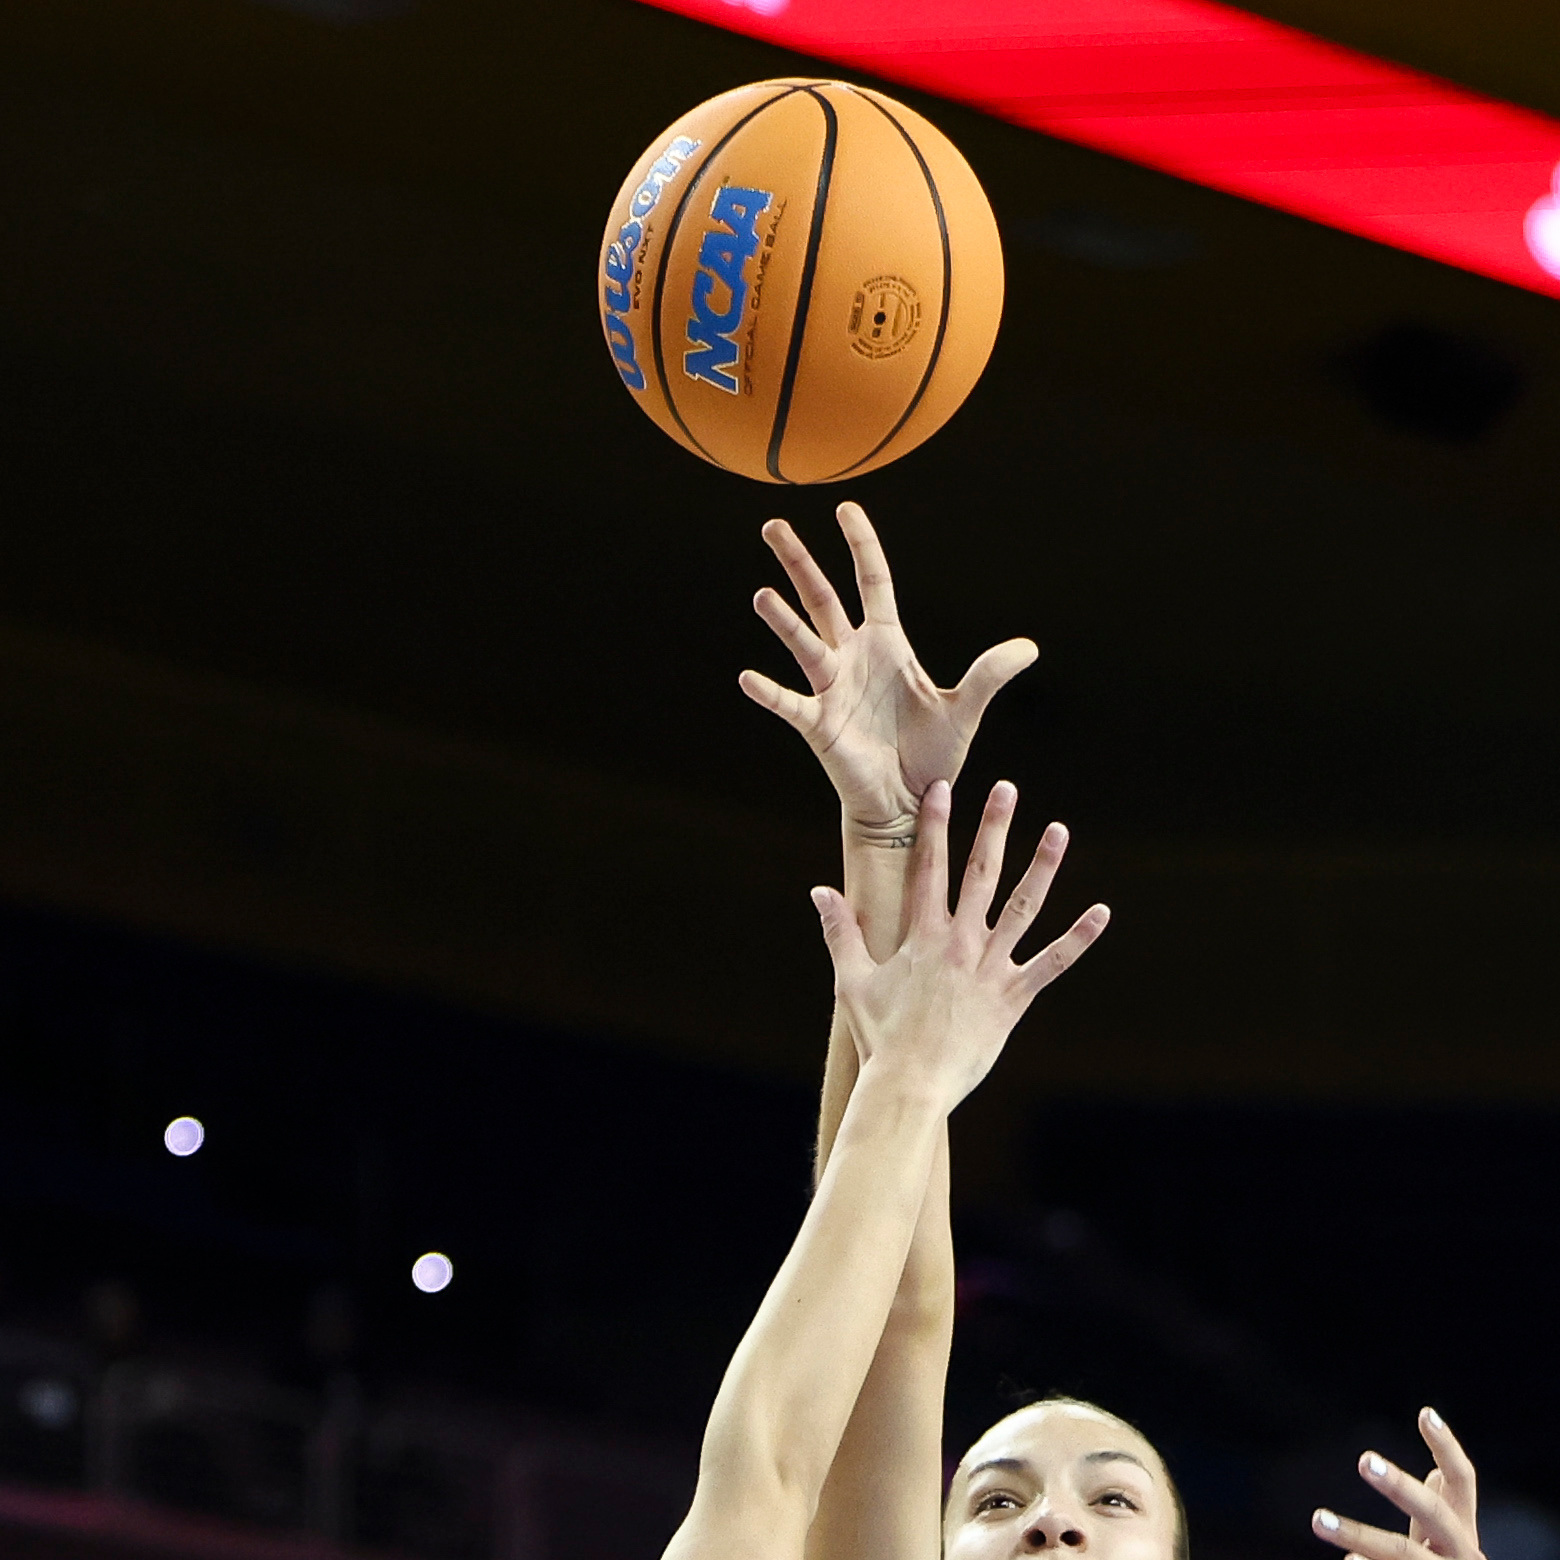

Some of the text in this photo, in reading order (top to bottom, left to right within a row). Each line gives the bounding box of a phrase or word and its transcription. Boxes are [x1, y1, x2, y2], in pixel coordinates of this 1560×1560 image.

[633, 268, 646, 310] EVO
[683, 185, 774, 396] NCAA
[751, 251, 772, 311] GAME
[765, 196, 789, 249] BALL
